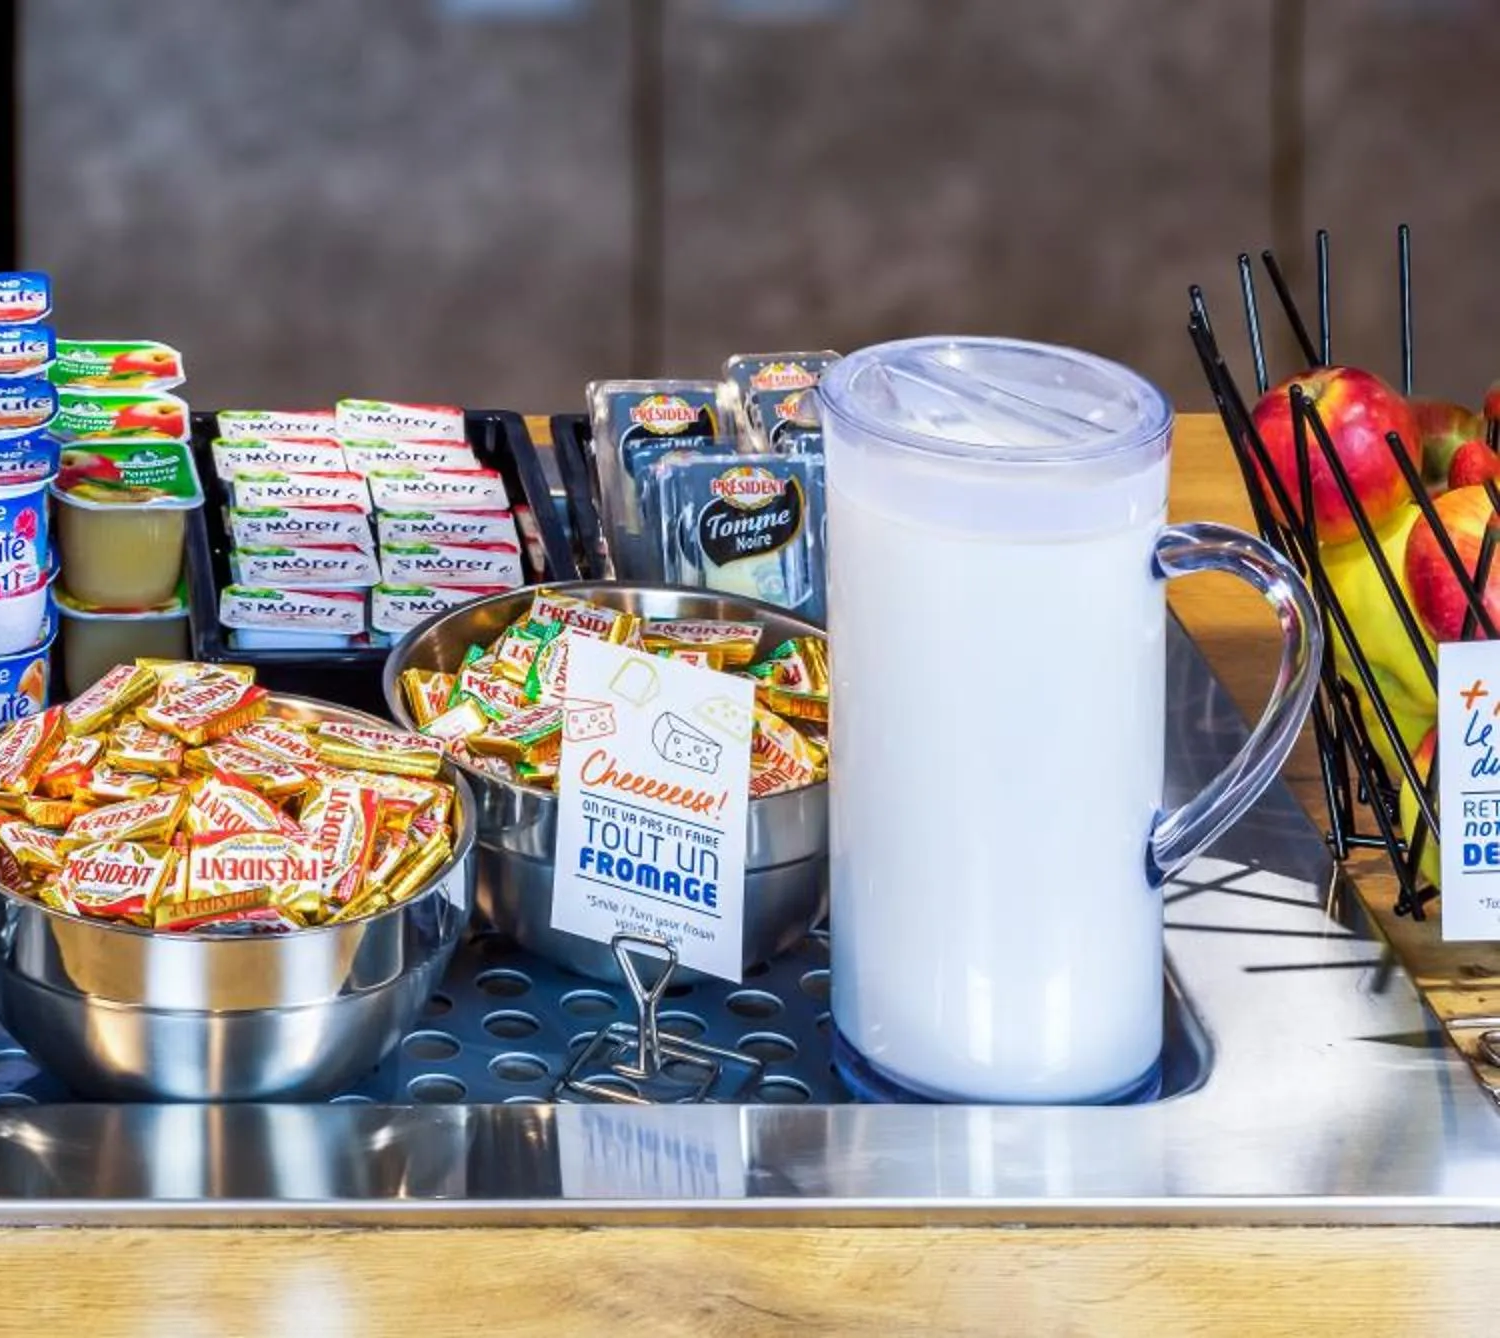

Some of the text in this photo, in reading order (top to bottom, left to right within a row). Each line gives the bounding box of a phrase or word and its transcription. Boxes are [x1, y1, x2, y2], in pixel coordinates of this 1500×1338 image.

[712, 478, 786, 496] PRÉSIDENT
[706, 510, 790, 540] Tomme
[736, 533, 772, 551] Noire
[538, 603, 614, 635] PRÉSID
[467, 675, 522, 709] PRÉSI
[1464, 709, 1493, 747] Le
[583, 799, 719, 849] ON NE VA PAS EN FAIRE
[583, 815, 719, 881] TOUT UN
[196, 857, 318, 884] PRÉSIDENT
[579, 847, 717, 909] FROMAGE
